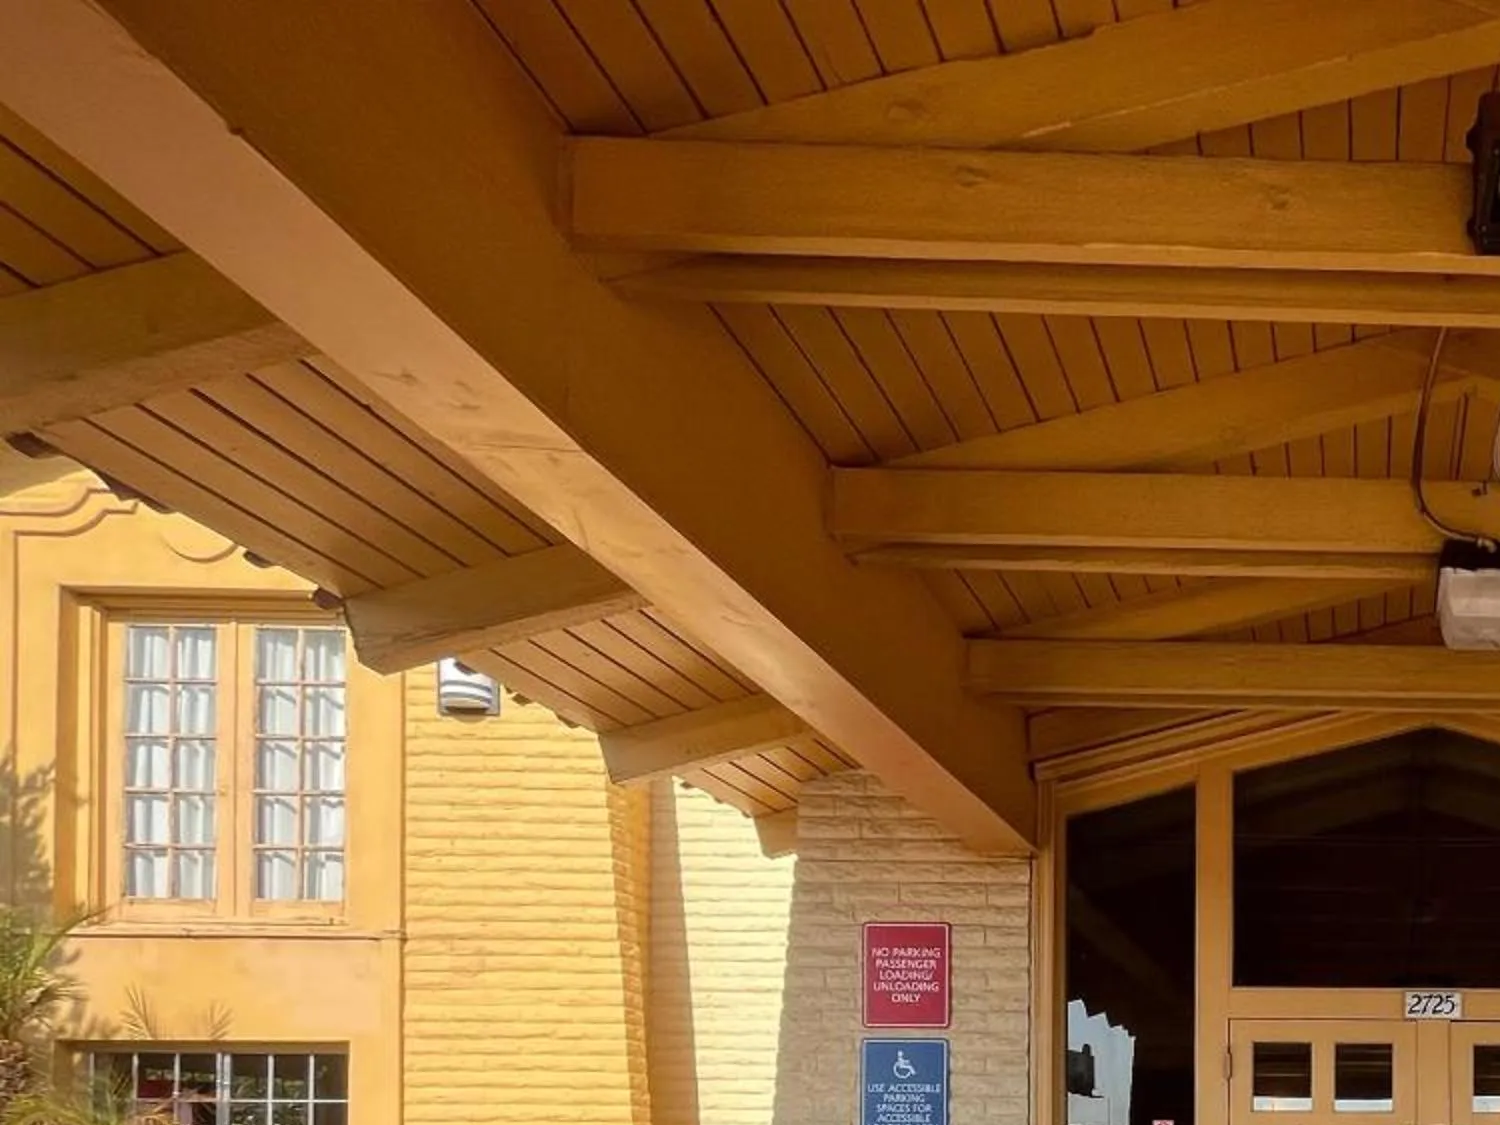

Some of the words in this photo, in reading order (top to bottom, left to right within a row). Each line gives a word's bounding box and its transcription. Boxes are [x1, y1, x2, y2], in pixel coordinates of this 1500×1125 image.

[872, 947, 890, 958] NO
[892, 947, 941, 958] PARKING
[875, 959, 937, 970] PASSENGER
[873, 982, 940, 992] UNLOADING
[891, 993, 920, 1003] ONLY
[1408, 994, 1455, 1015] 2725
[867, 1083, 885, 1093] USE
[887, 1083, 941, 1093] ACCESSIBLE
[883, 1093, 925, 1103] PARKING
[877, 1103, 911, 1113] SPACES
[913, 1103, 933, 1113] FOR
[877, 1113, 931, 1123] ACCESSIBLE
